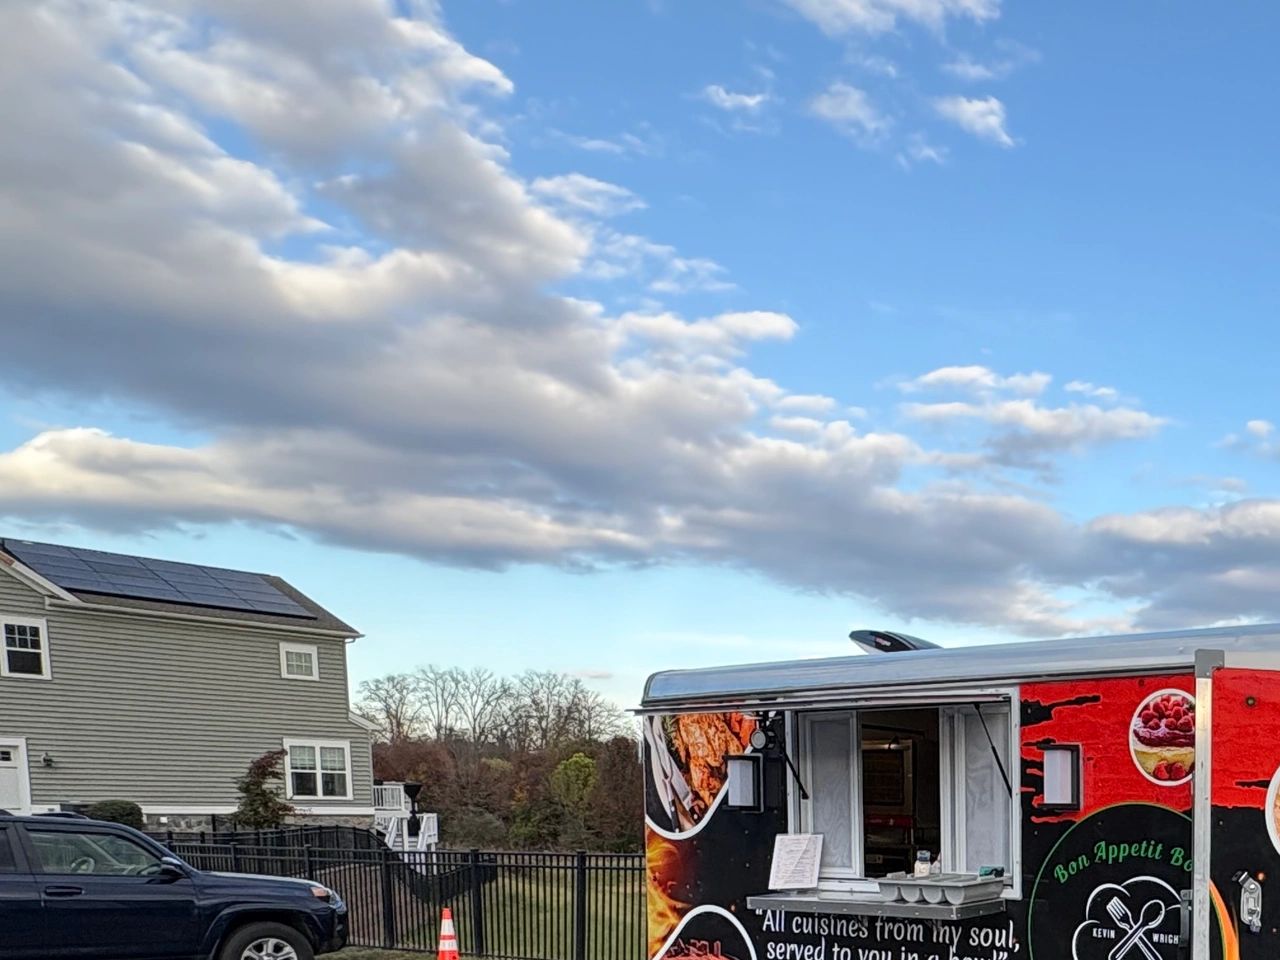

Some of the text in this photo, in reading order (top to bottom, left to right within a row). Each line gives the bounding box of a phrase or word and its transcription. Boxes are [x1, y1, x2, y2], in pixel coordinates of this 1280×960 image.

[1054, 840, 1193, 884] Bon Appetit Bo
[792, 912, 869, 938] cuisines
[876, 914, 924, 942] from
[933, 920, 962, 953] my
[969, 920, 1020, 952] soul,
[1092, 927, 1180, 945] KEVIN WRIGH
